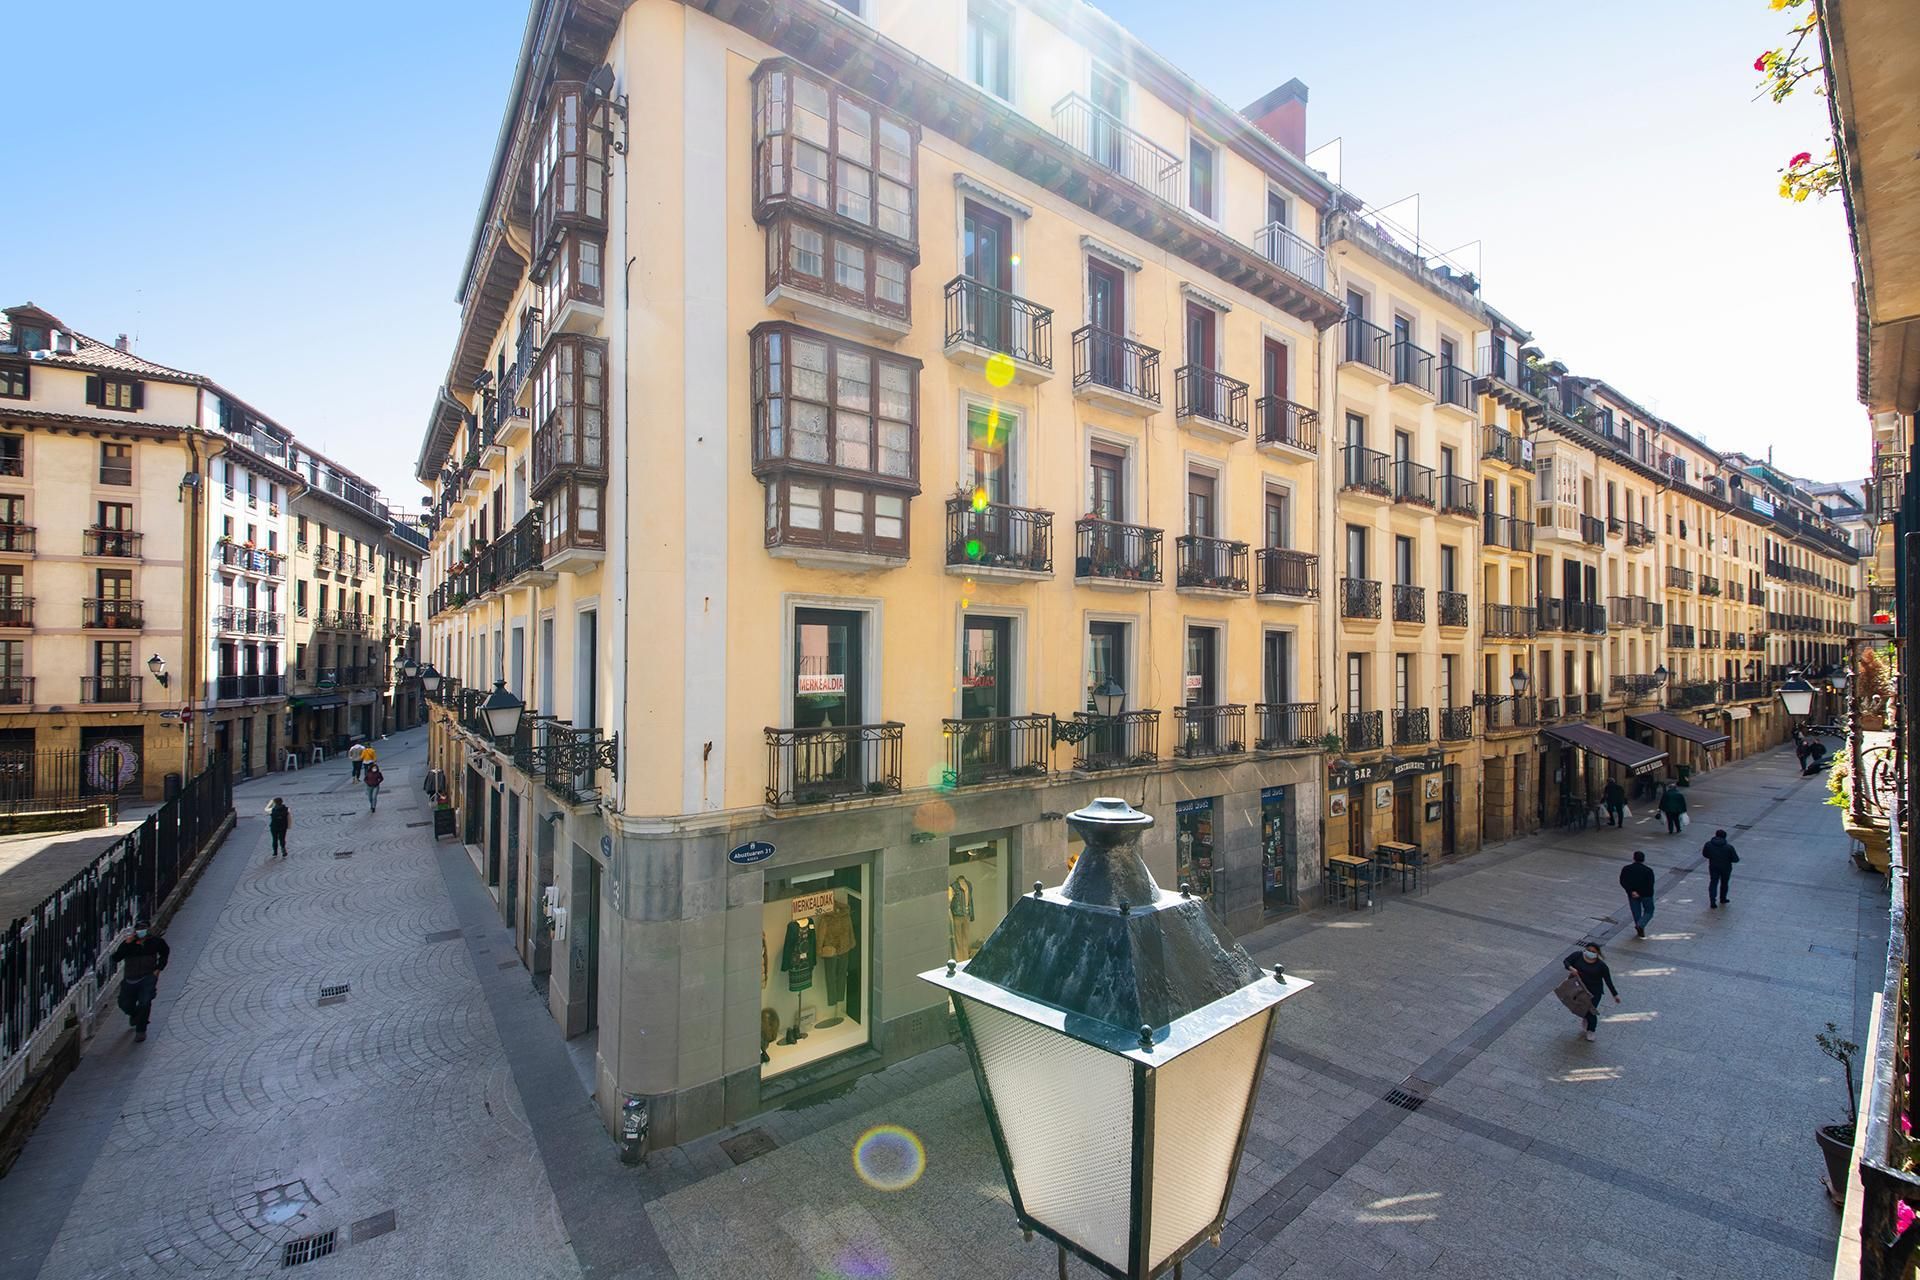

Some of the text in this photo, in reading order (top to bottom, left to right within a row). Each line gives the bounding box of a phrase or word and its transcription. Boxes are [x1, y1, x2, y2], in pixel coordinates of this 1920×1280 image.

[1354, 768, 1372, 780] BAR
[733, 850, 764, 859] Abuztuaren
[792, 893, 833, 913] MERKEALDIAK
